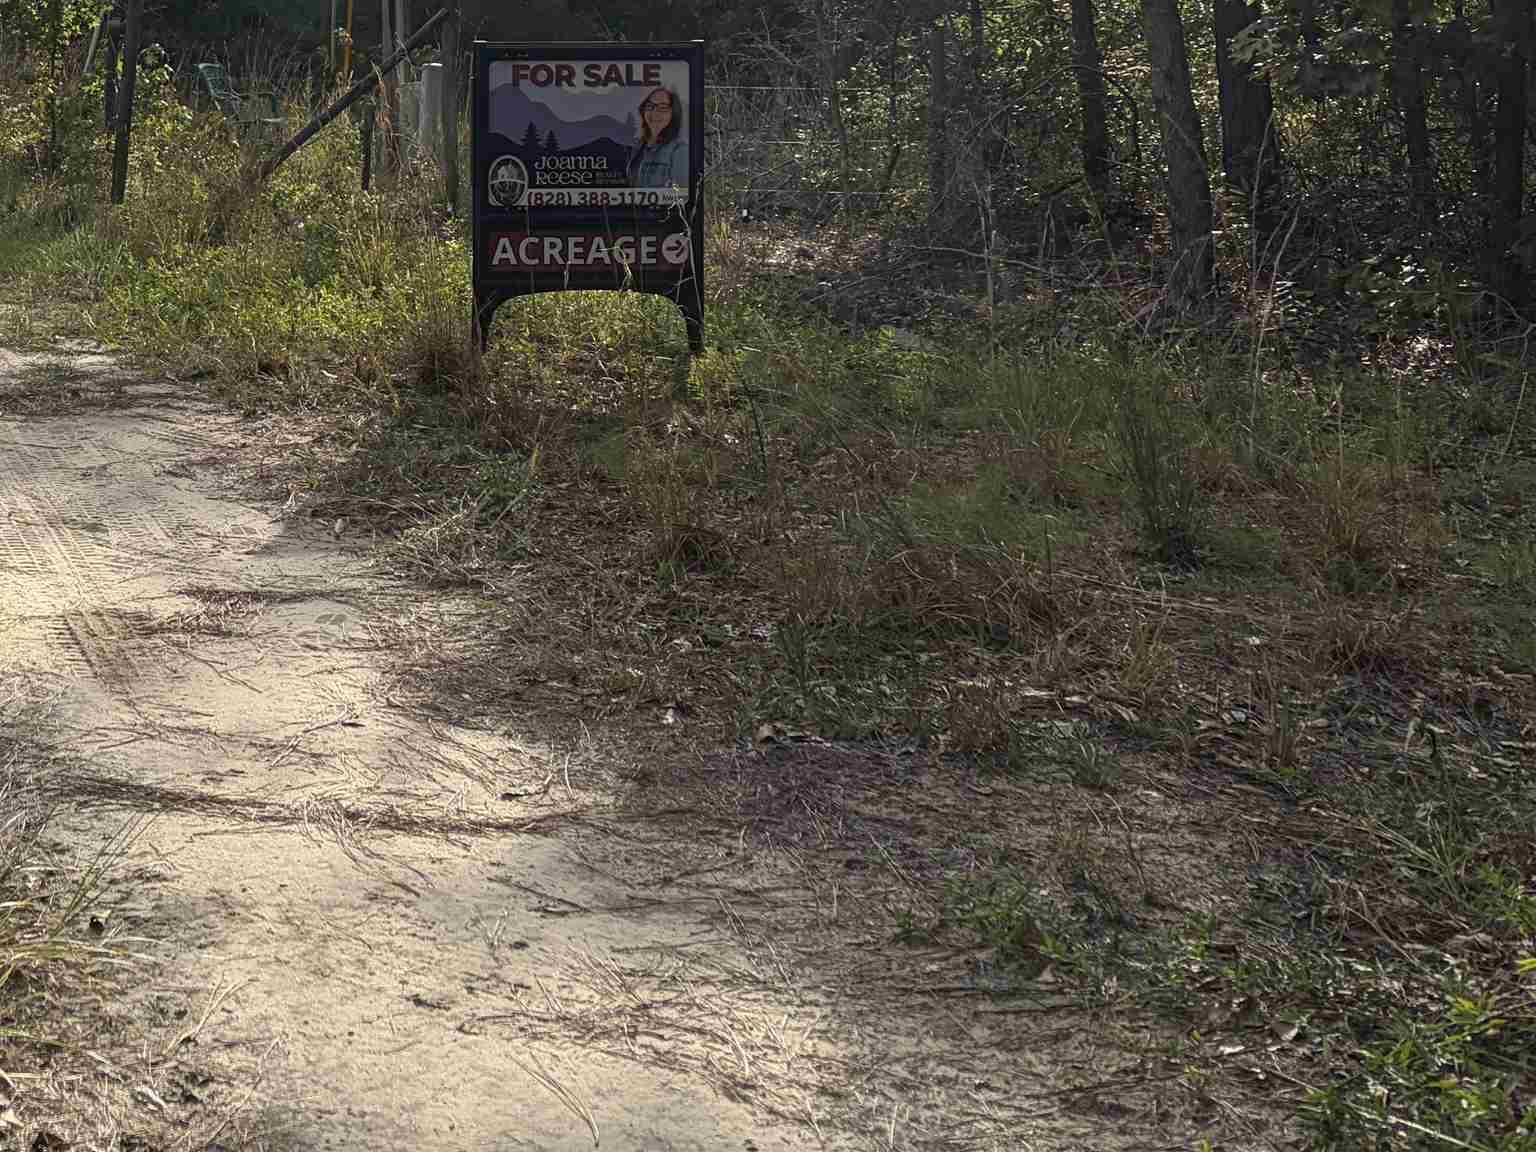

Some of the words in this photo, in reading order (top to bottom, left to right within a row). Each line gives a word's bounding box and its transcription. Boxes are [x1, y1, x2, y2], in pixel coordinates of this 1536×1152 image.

[511, 63, 576, 87] FOR
[583, 63, 662, 87] SALE
[534, 154, 608, 170] Joanna
[535, 171, 594, 186] Reese
[527, 191, 572, 207] (828)
[492, 236, 658, 266] ACREAGE
